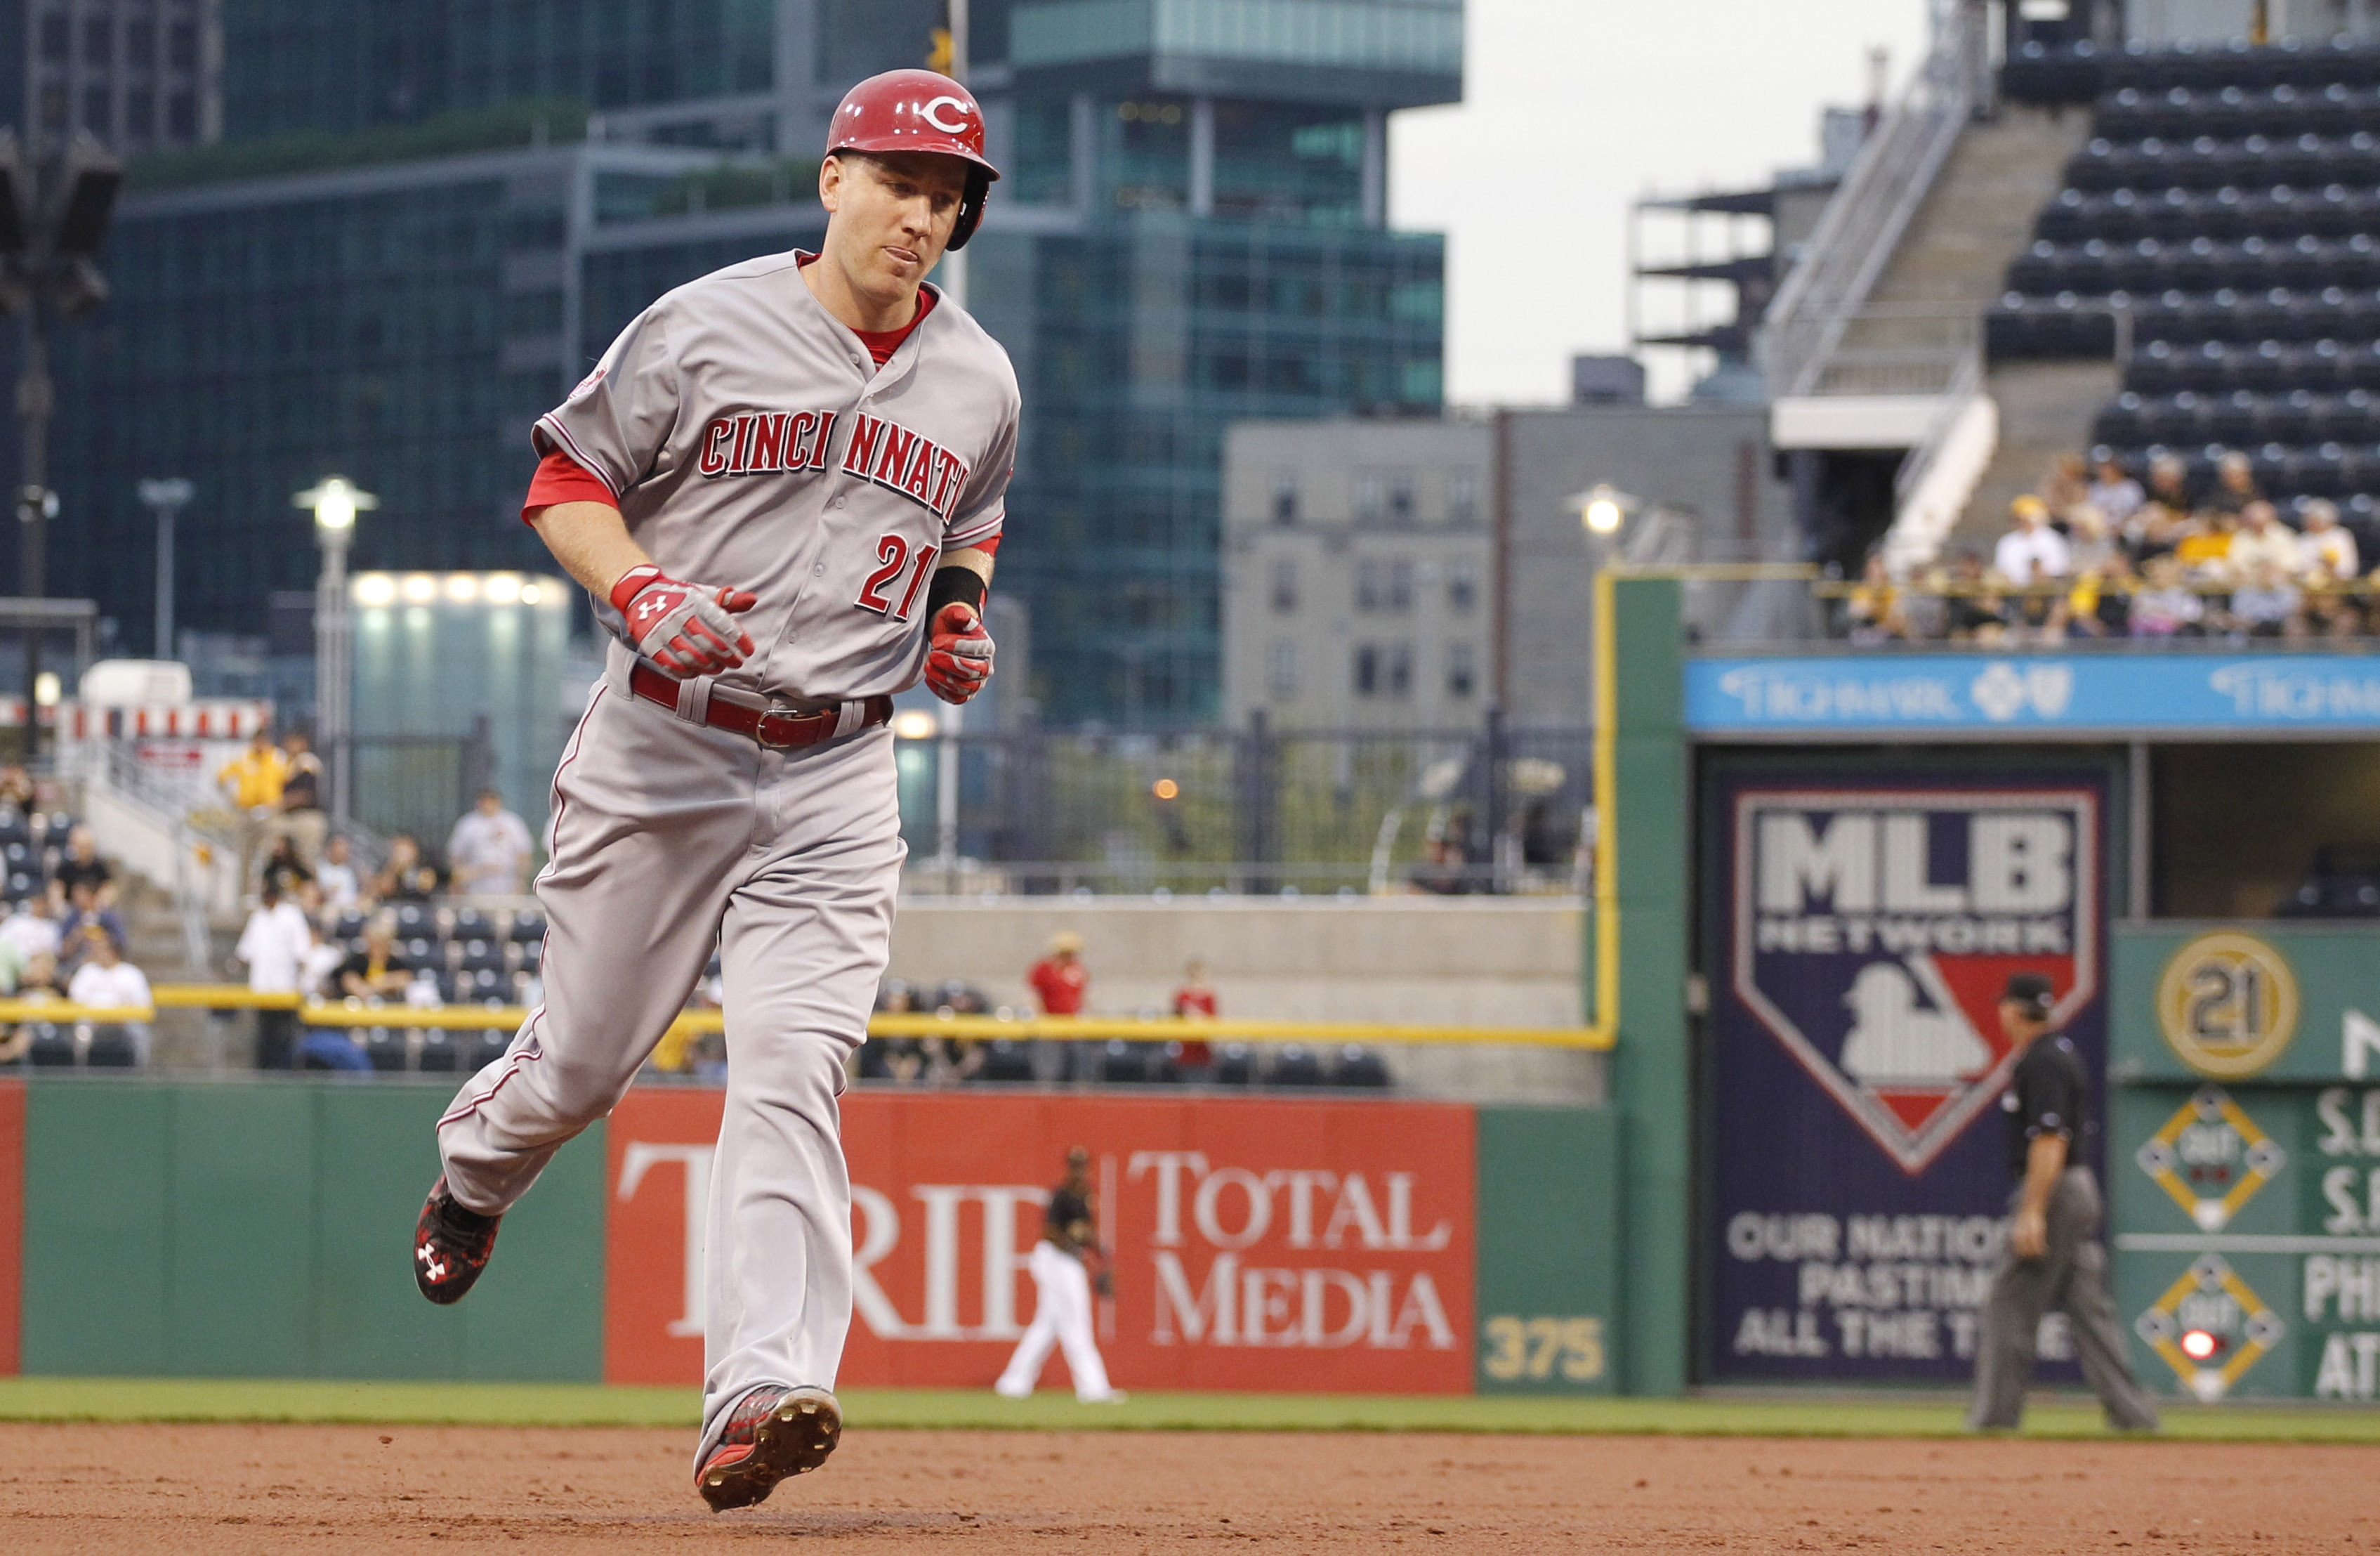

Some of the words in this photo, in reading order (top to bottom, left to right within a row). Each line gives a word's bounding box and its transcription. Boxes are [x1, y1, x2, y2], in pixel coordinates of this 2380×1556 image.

[920, 96, 968, 134] C
[854, 532, 939, 622] 21
[1758, 813, 2072, 912] MLB
[1758, 917, 2070, 954] NETWORK
[2186, 960, 2263, 1042] 21
[1126, 1150, 1453, 1252] TOTAL
[1726, 1210, 1841, 1262] OUR
[1846, 1213, 2016, 1262] NATIO
[1150, 1248, 1455, 1351] MEDIA
[1799, 1263, 1996, 1309] PASTIM
[1482, 1316, 1605, 1382] 375
[1734, 1307, 1829, 1358] ALL
[1834, 1309, 1942, 1359] THE
[1946, 1311, 2073, 1361] TE
